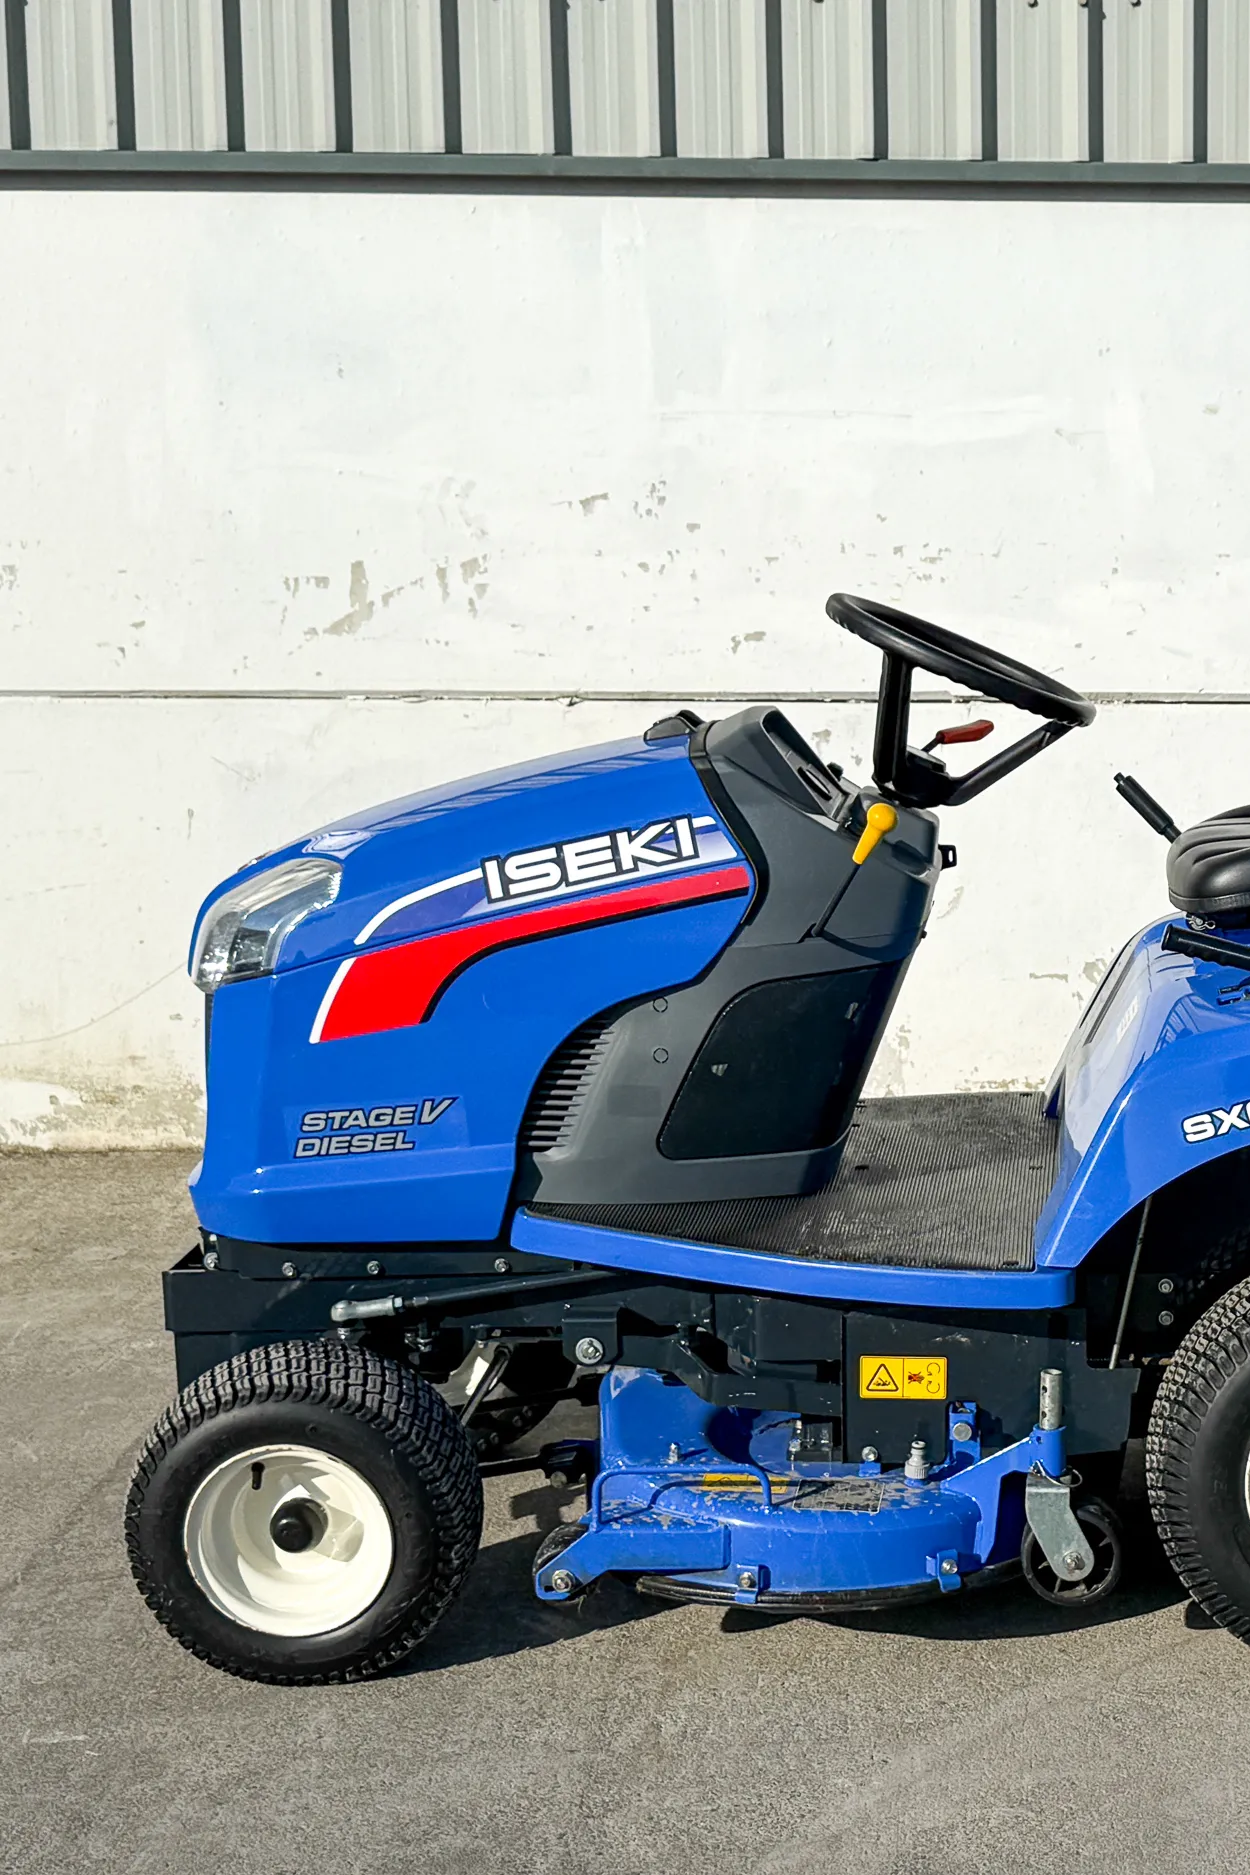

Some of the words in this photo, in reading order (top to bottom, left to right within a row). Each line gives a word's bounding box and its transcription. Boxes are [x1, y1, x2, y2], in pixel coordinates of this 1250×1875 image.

[482, 815, 699, 902] ISEKI
[301, 1109, 418, 1132] STAGE
[418, 1097, 458, 1125] V
[294, 1131, 416, 1158] DIESEL
